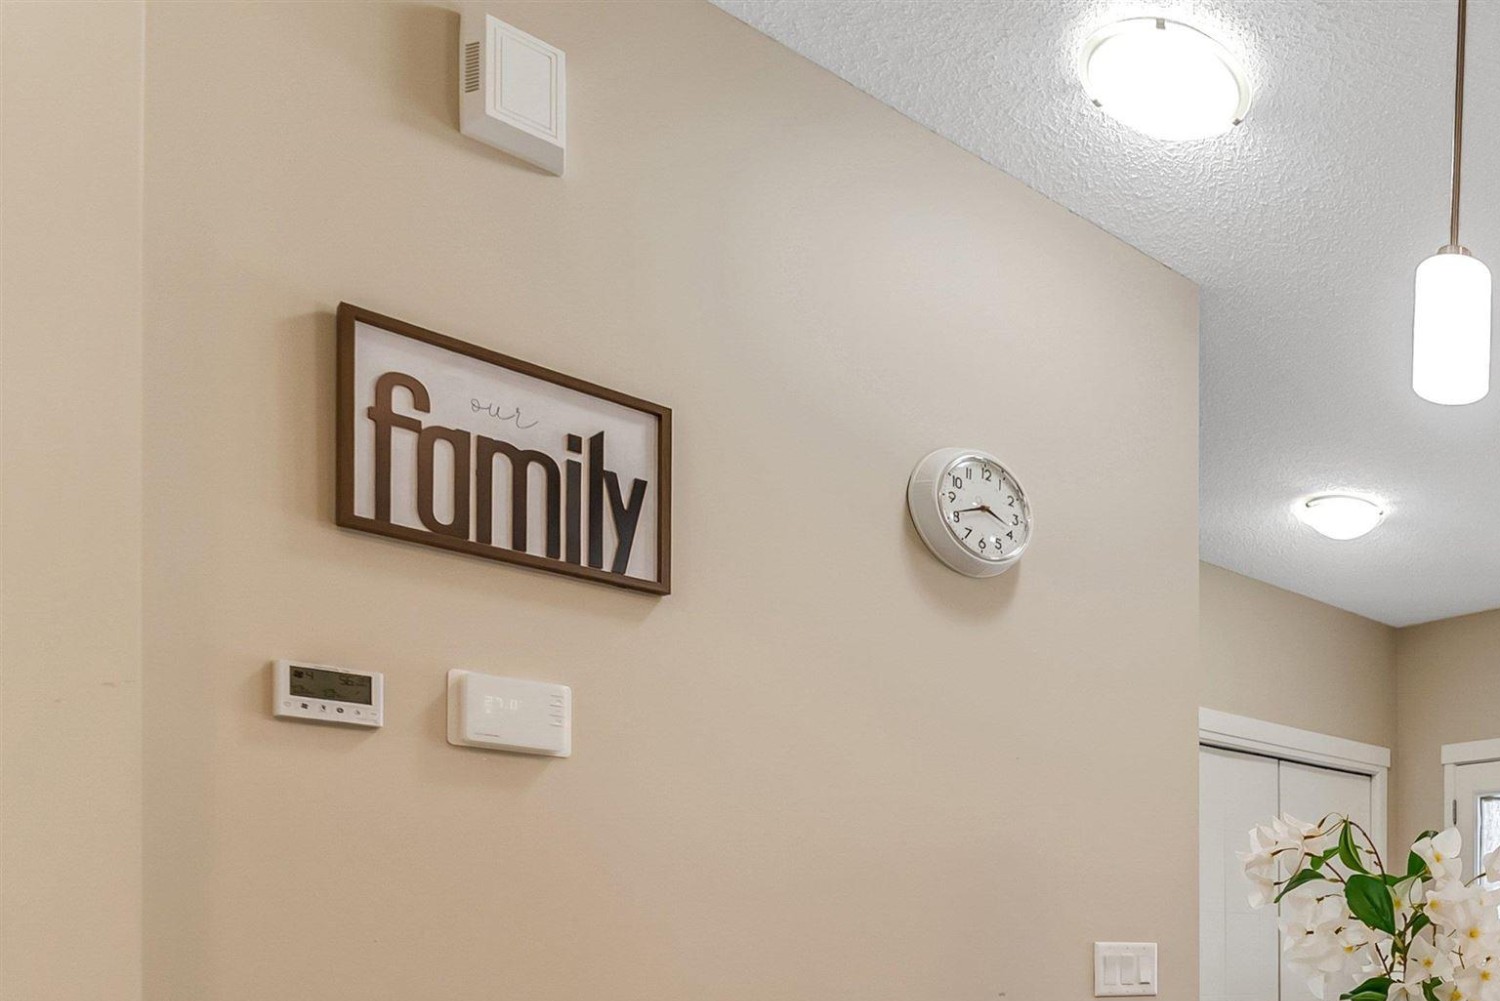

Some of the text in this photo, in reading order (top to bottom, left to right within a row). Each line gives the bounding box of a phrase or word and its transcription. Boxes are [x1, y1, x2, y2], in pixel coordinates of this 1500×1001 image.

[470, 398, 539, 429] our
[367, 371, 648, 574] family
[982, 467, 992, 482] 12
[952, 475, 963, 489] 10
[948, 491, 956, 503] 9
[1007, 495, 1015, 507] 2
[953, 510, 960, 523] 8
[1012, 514, 1019, 526] 3
[964, 528, 972, 539] 7
[1006, 530, 1013, 541] 4
[978, 538, 986, 549] 6
[995, 538, 1002, 550] 5
